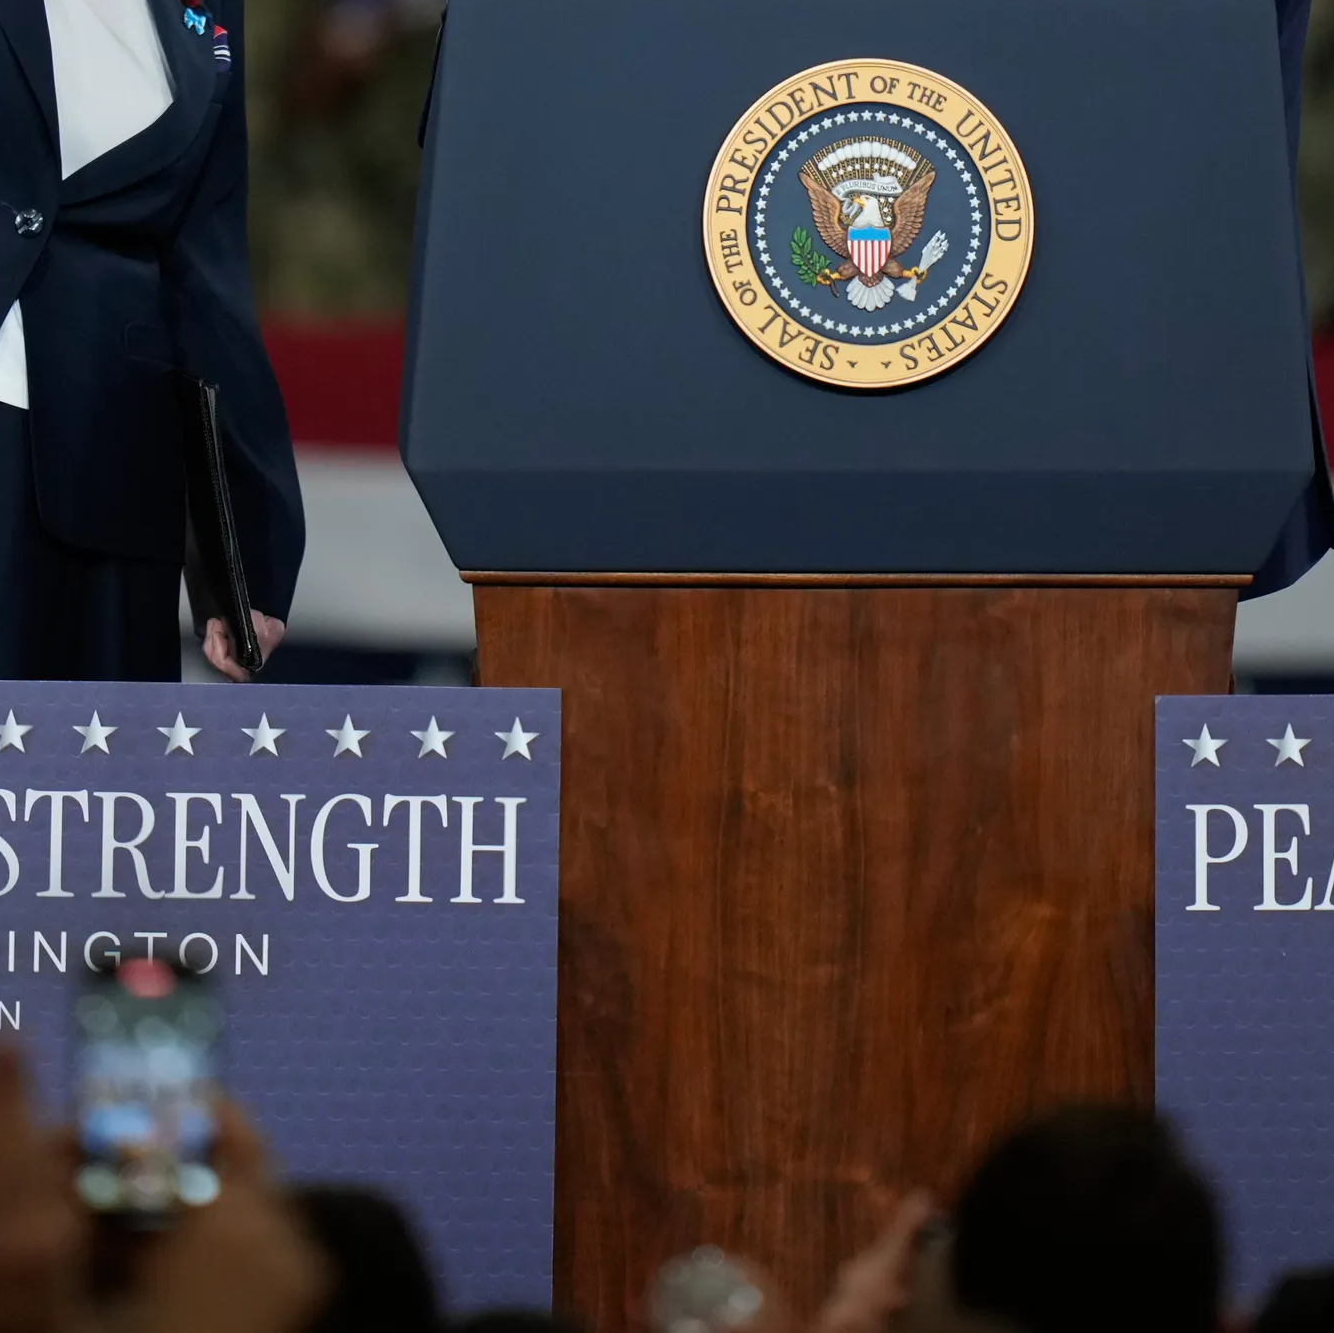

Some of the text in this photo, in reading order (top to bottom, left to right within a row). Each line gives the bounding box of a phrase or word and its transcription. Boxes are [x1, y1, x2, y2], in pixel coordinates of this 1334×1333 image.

[717, 71, 1022, 371] SEAL OF THE PRESIDENT OF THE UNITED STATES
[840, 180, 877, 192] PLURIBUS
[877, 184, 899, 193] UNUM
